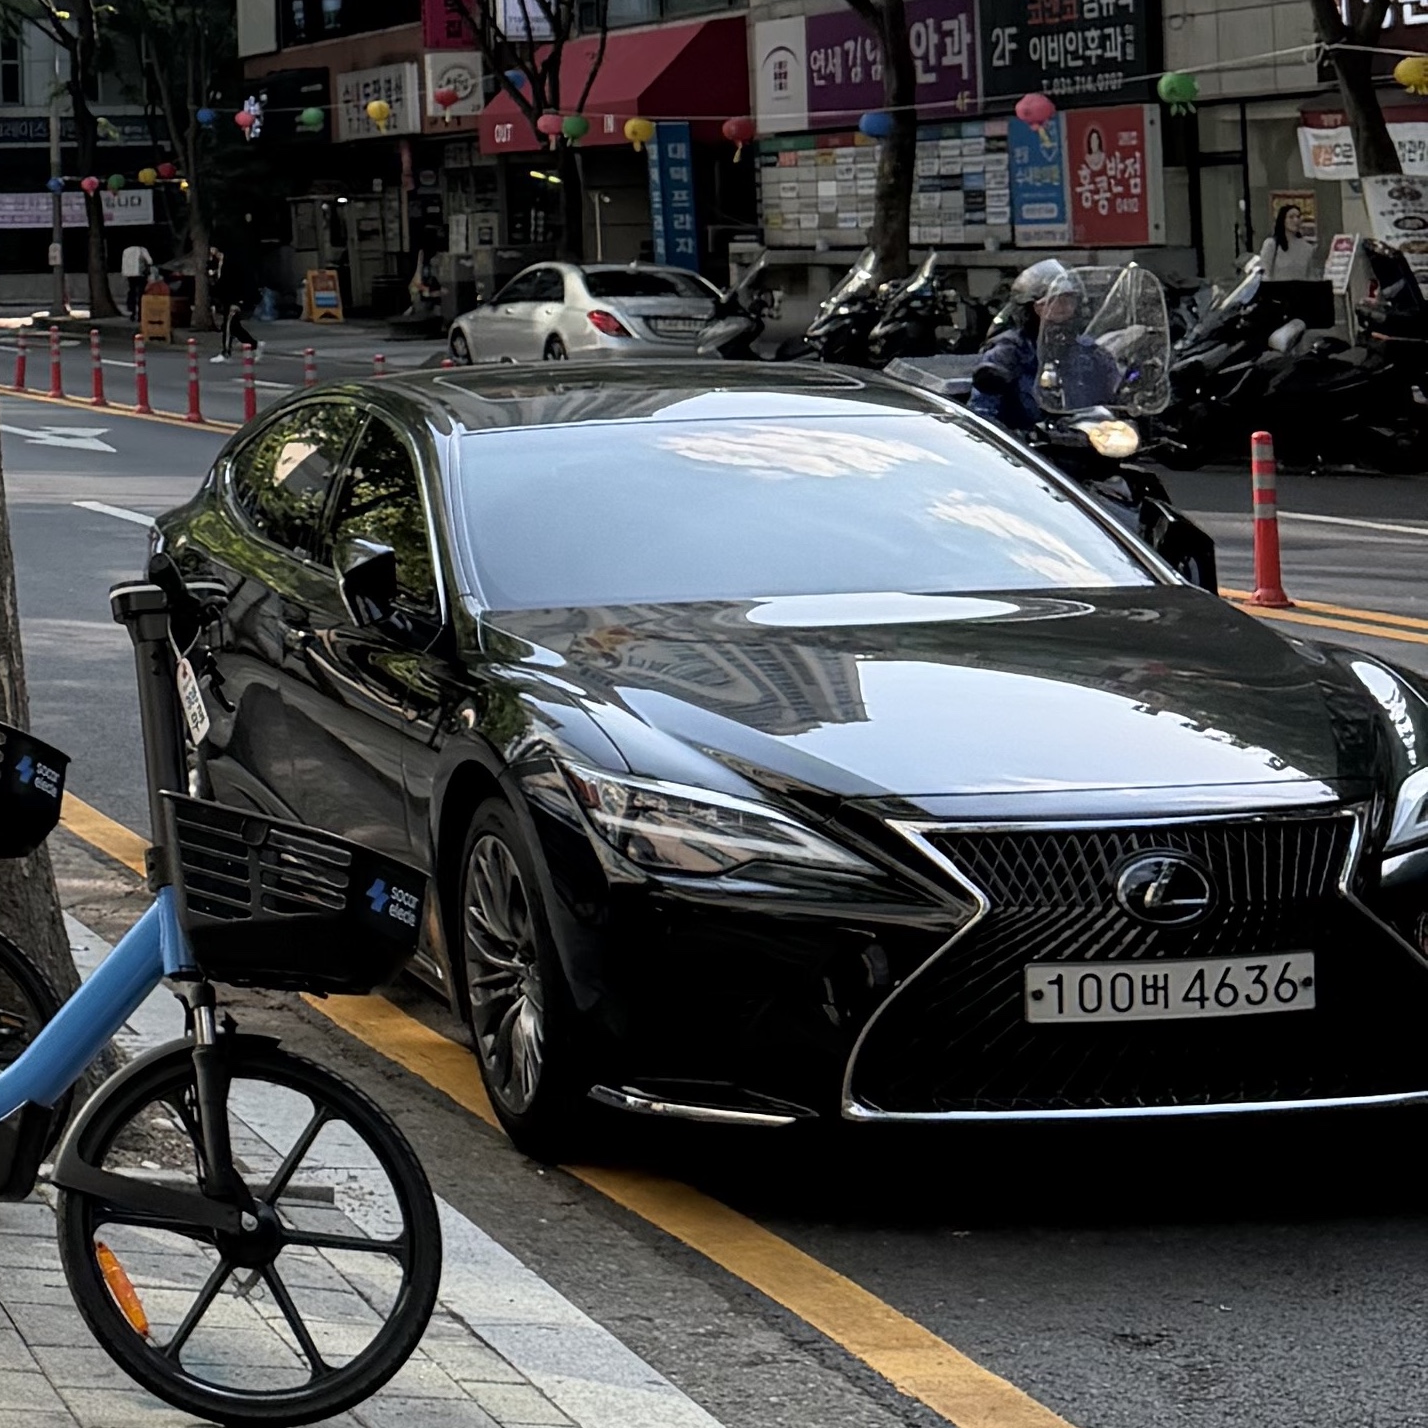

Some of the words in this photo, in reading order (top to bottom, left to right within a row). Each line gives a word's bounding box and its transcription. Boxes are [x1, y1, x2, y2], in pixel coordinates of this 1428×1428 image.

[908, 12, 973, 81] 안과
[991, 25, 1019, 68] 2F
[1028, 18, 1123, 70] 이비인후과
[494, 123, 514, 144] OUT
[667, 142, 694, 254] 대덕프라자
[36, 762, 60, 784] socar
[390, 886, 419, 910] socar
[1181, 961, 1300, 1010] 4636
